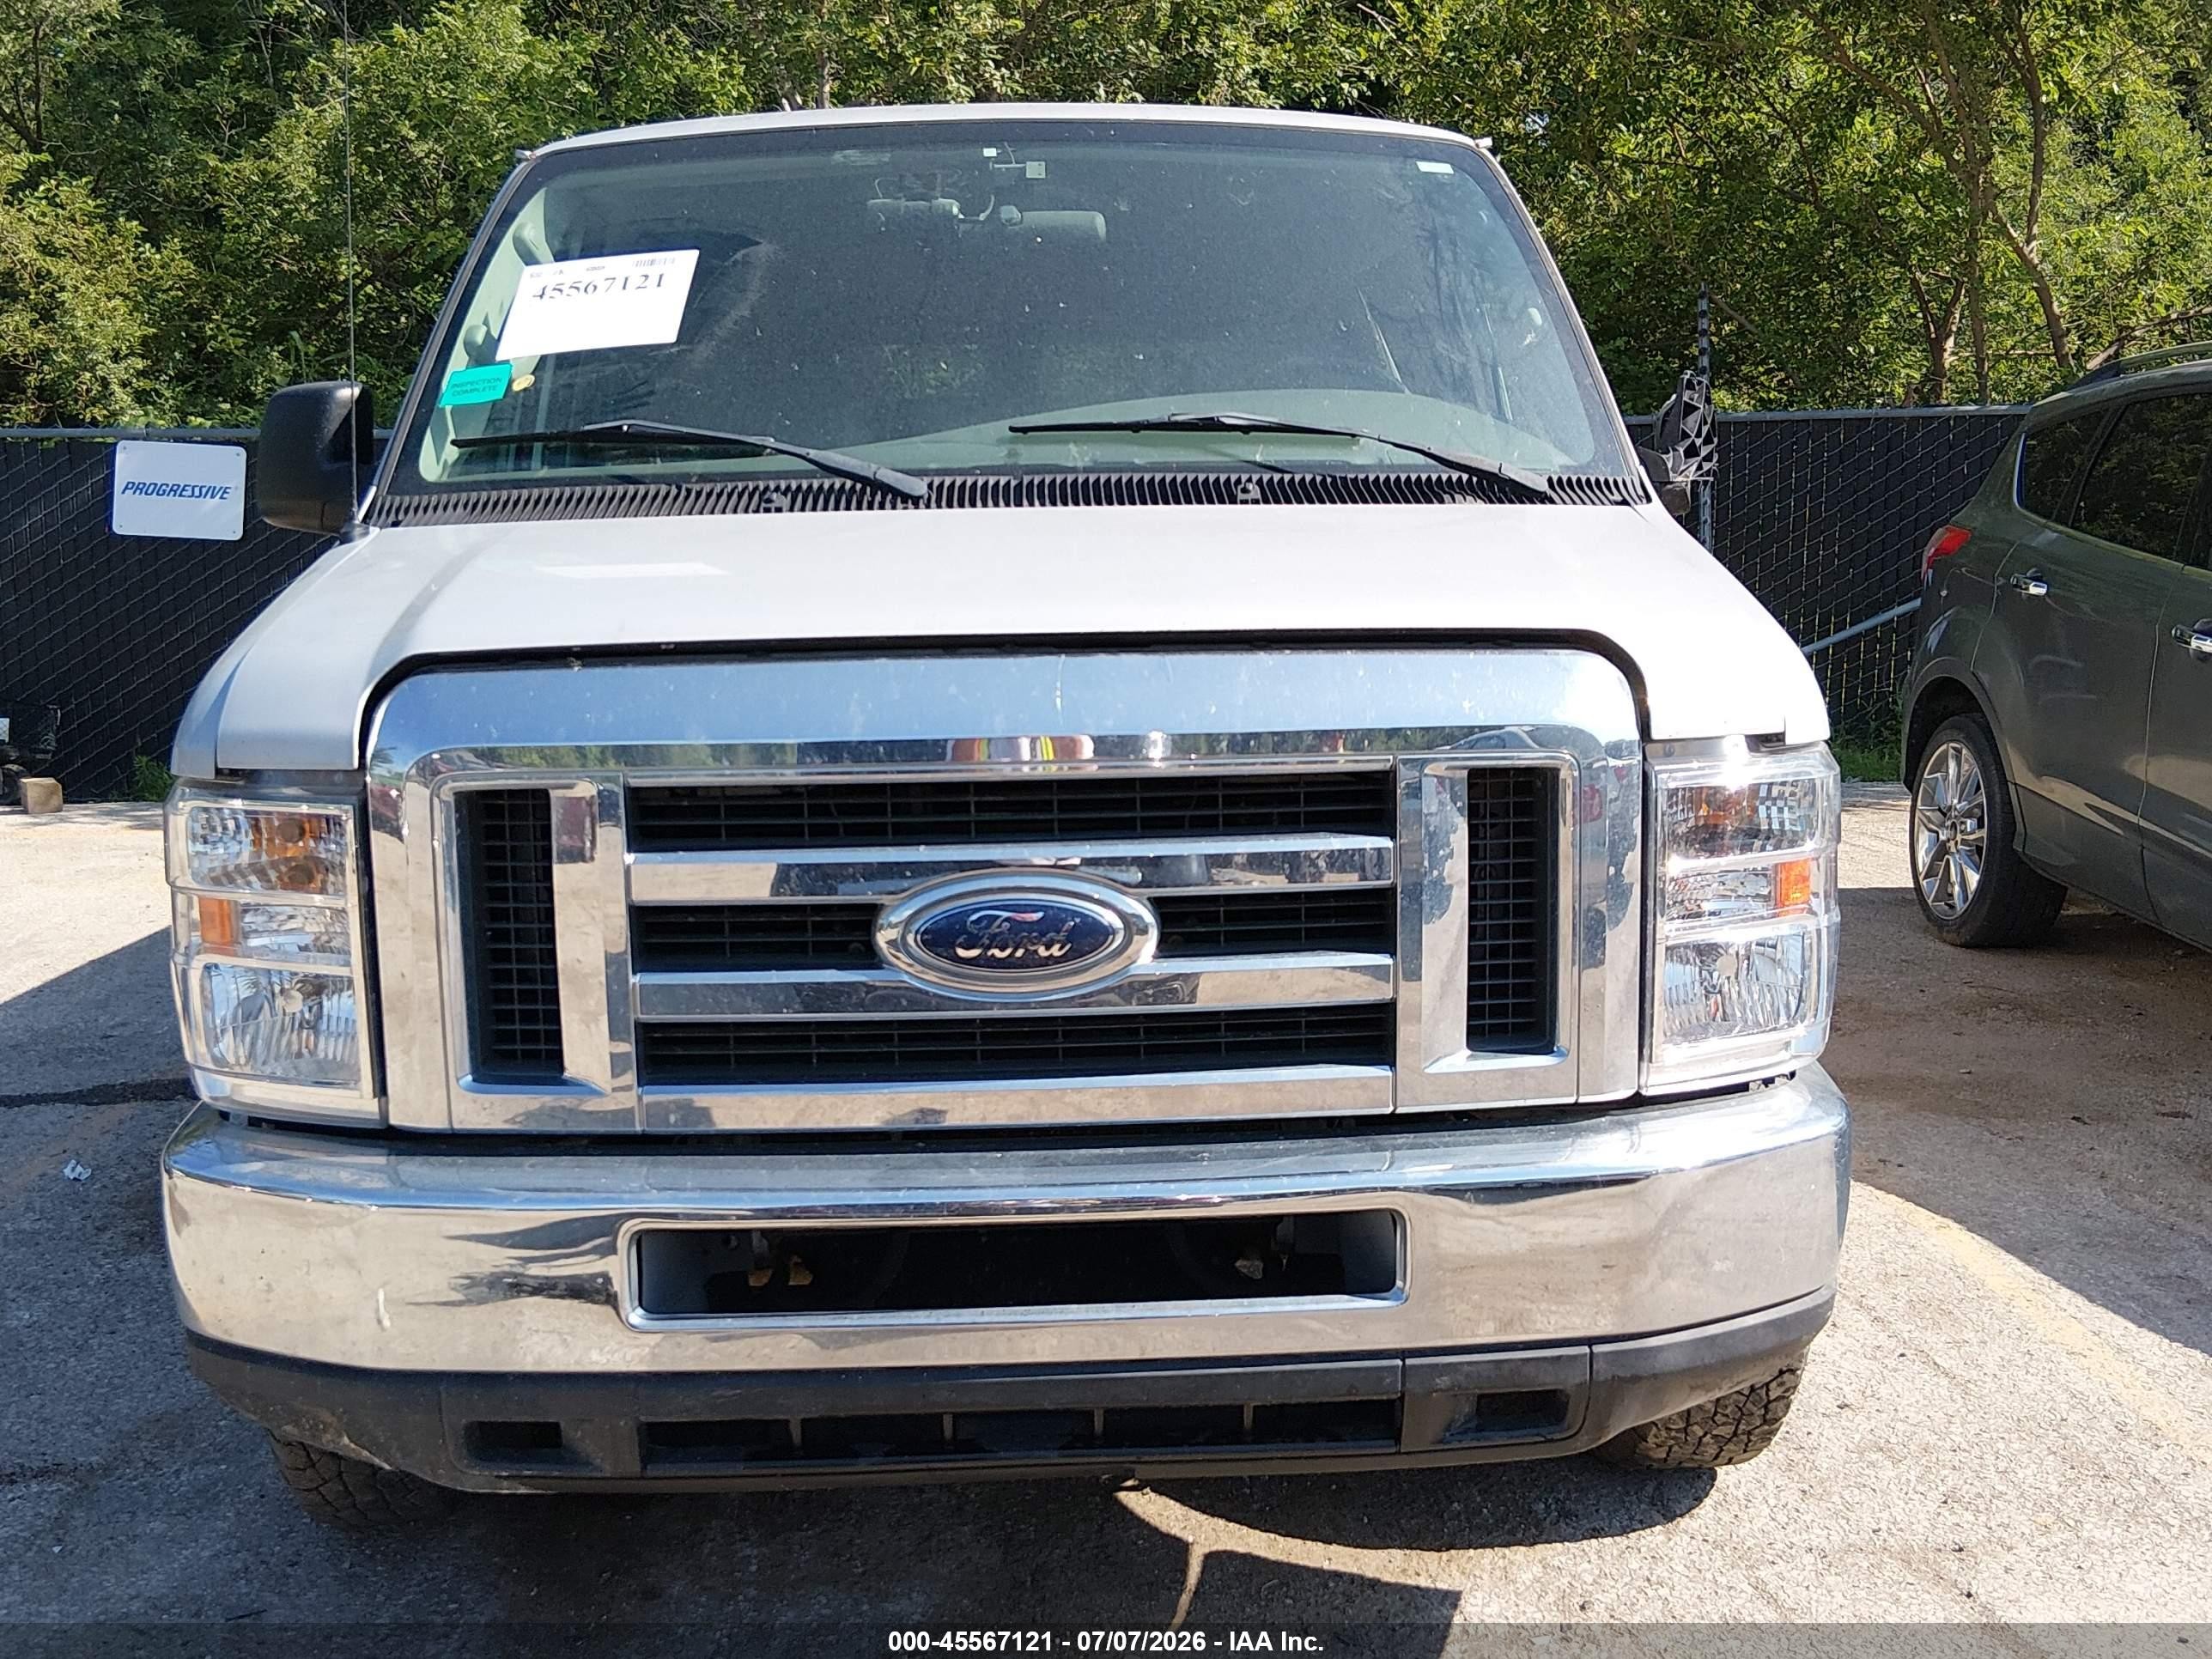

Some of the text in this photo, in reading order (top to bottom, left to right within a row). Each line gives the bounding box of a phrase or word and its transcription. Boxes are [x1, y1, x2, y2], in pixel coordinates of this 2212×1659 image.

[532, 272, 665, 300] 45567121
[121, 481, 232, 500] PROGRESSIVE
[954, 910, 1076, 959] Ford
